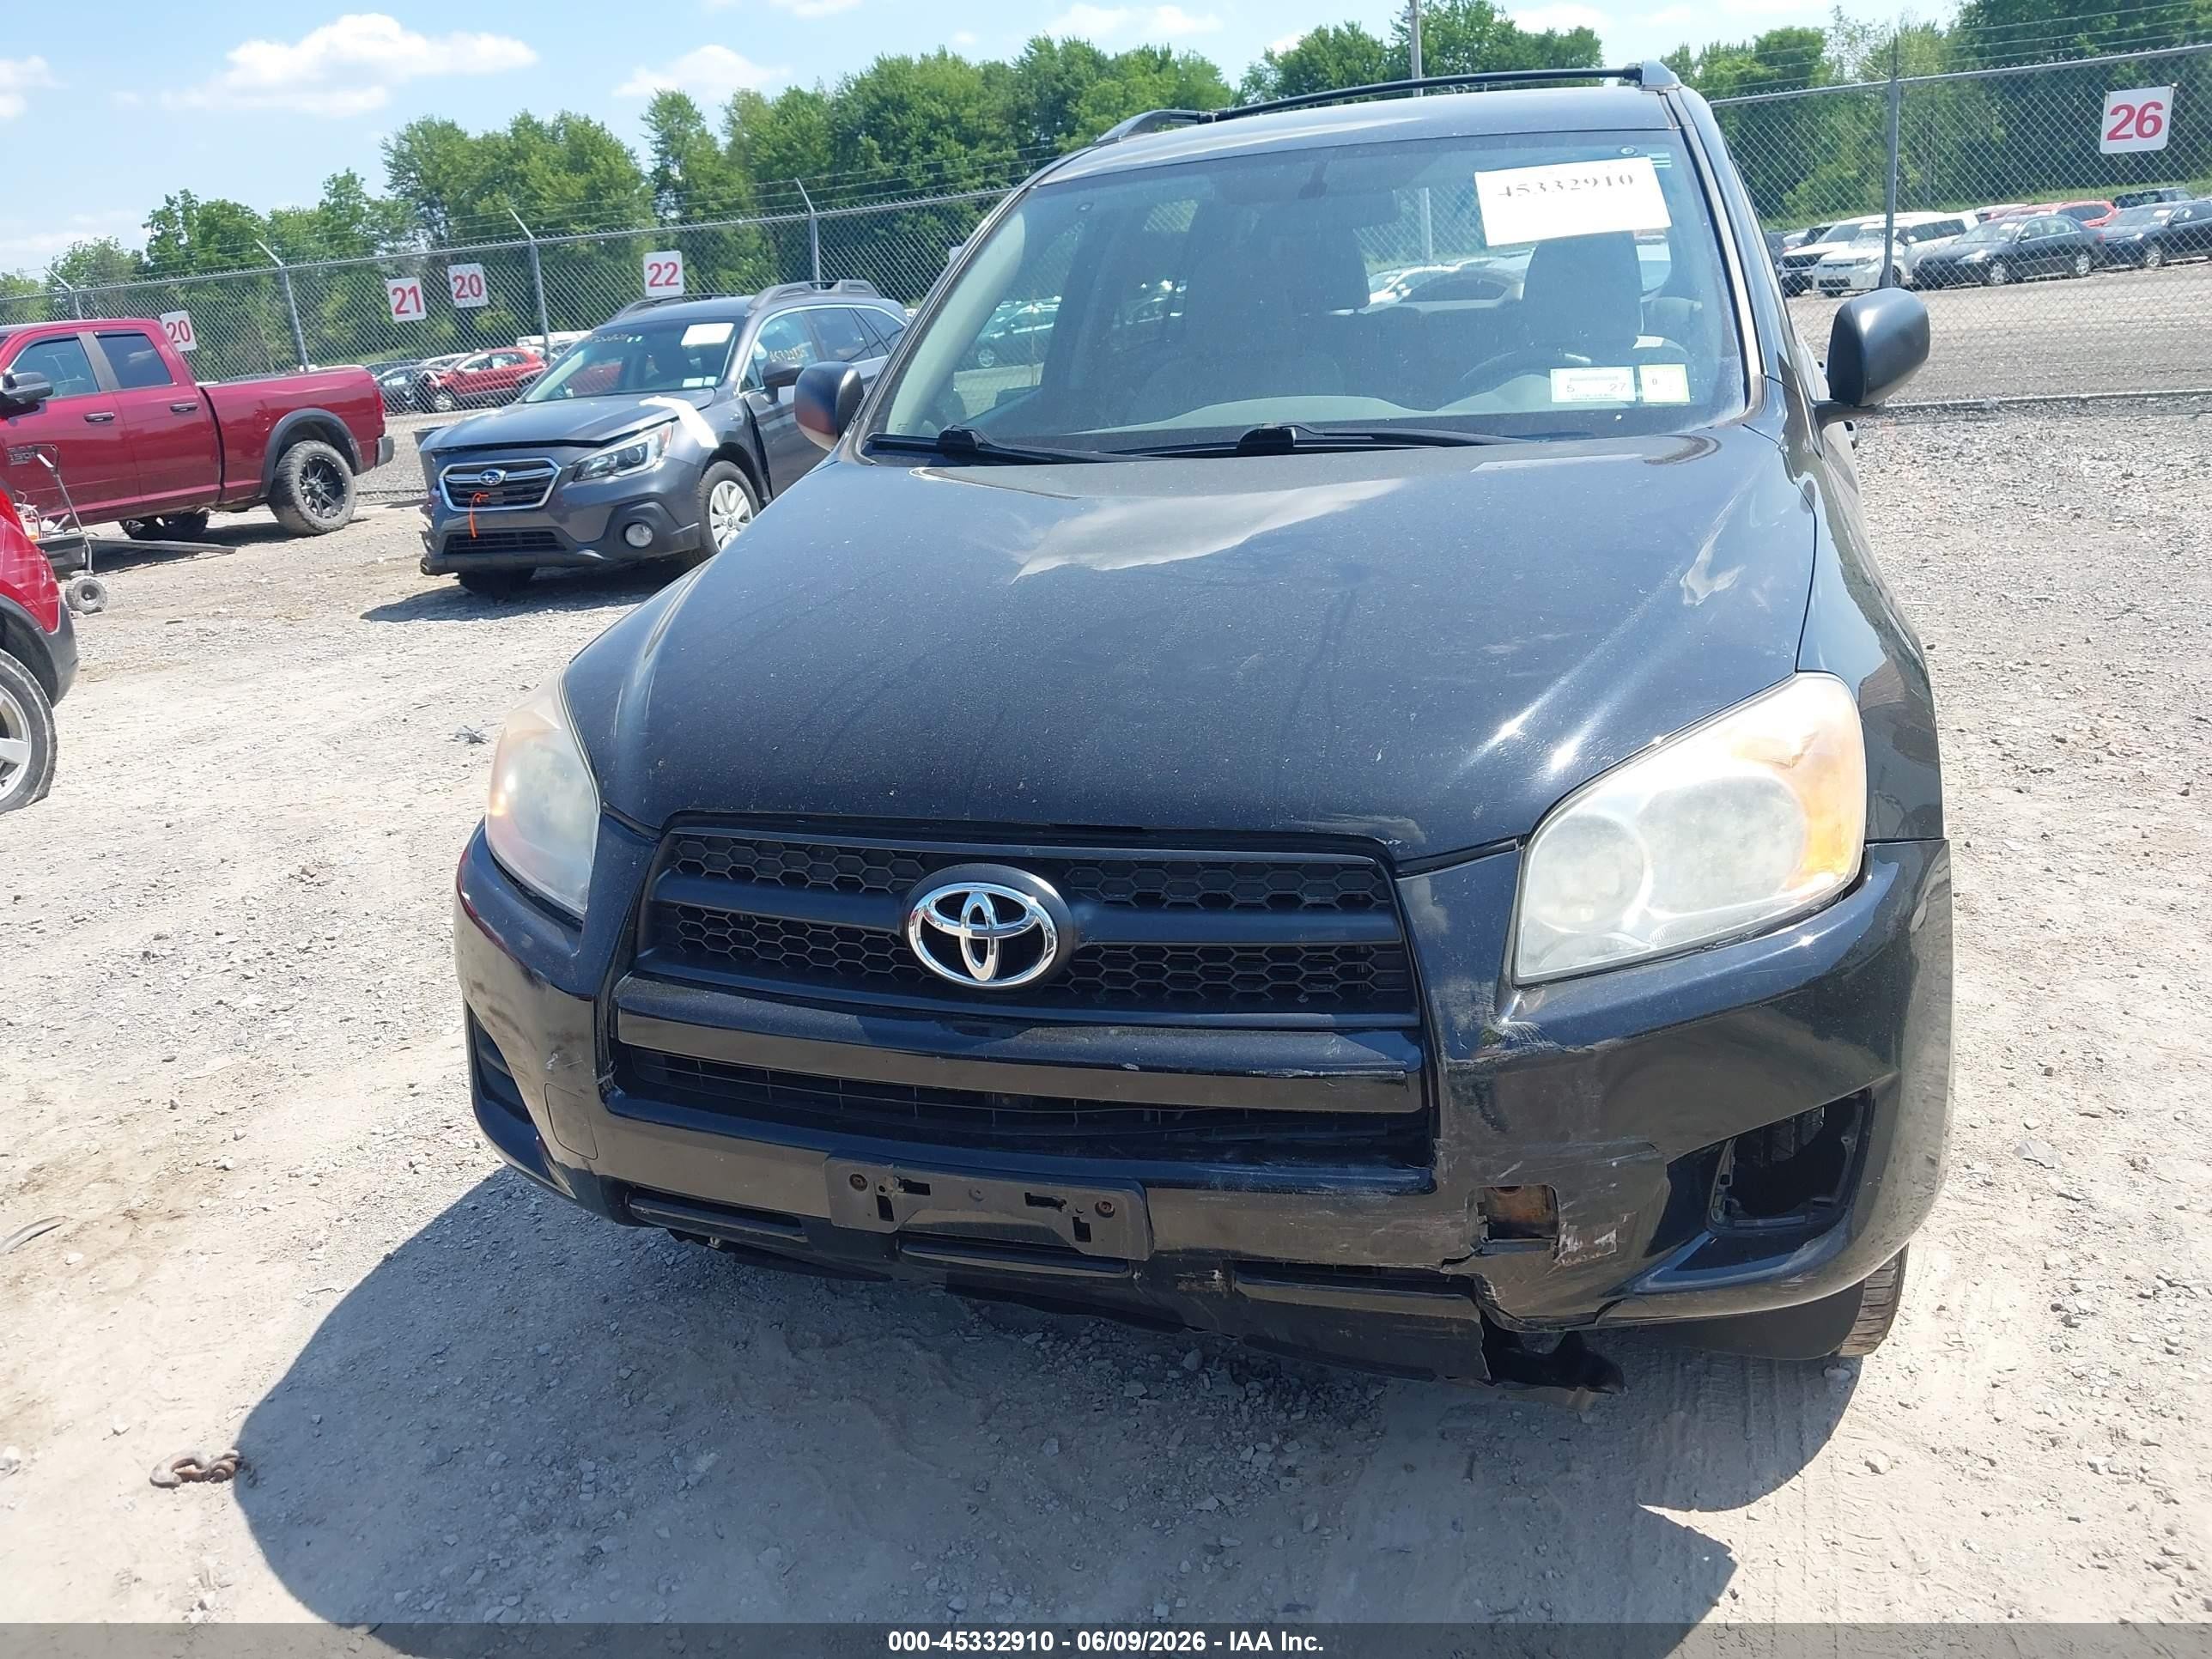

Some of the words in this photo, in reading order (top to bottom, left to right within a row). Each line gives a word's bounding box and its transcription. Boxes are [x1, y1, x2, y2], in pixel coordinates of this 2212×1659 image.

[2106, 100, 2164, 141] 26
[1498, 173, 1634, 198] 45332910
[453, 273, 483, 299] 20
[647, 261, 679, 287] 22
[392, 285, 422, 315] 21
[166, 319, 191, 343] 20
[1608, 382, 1627, 392] 27
